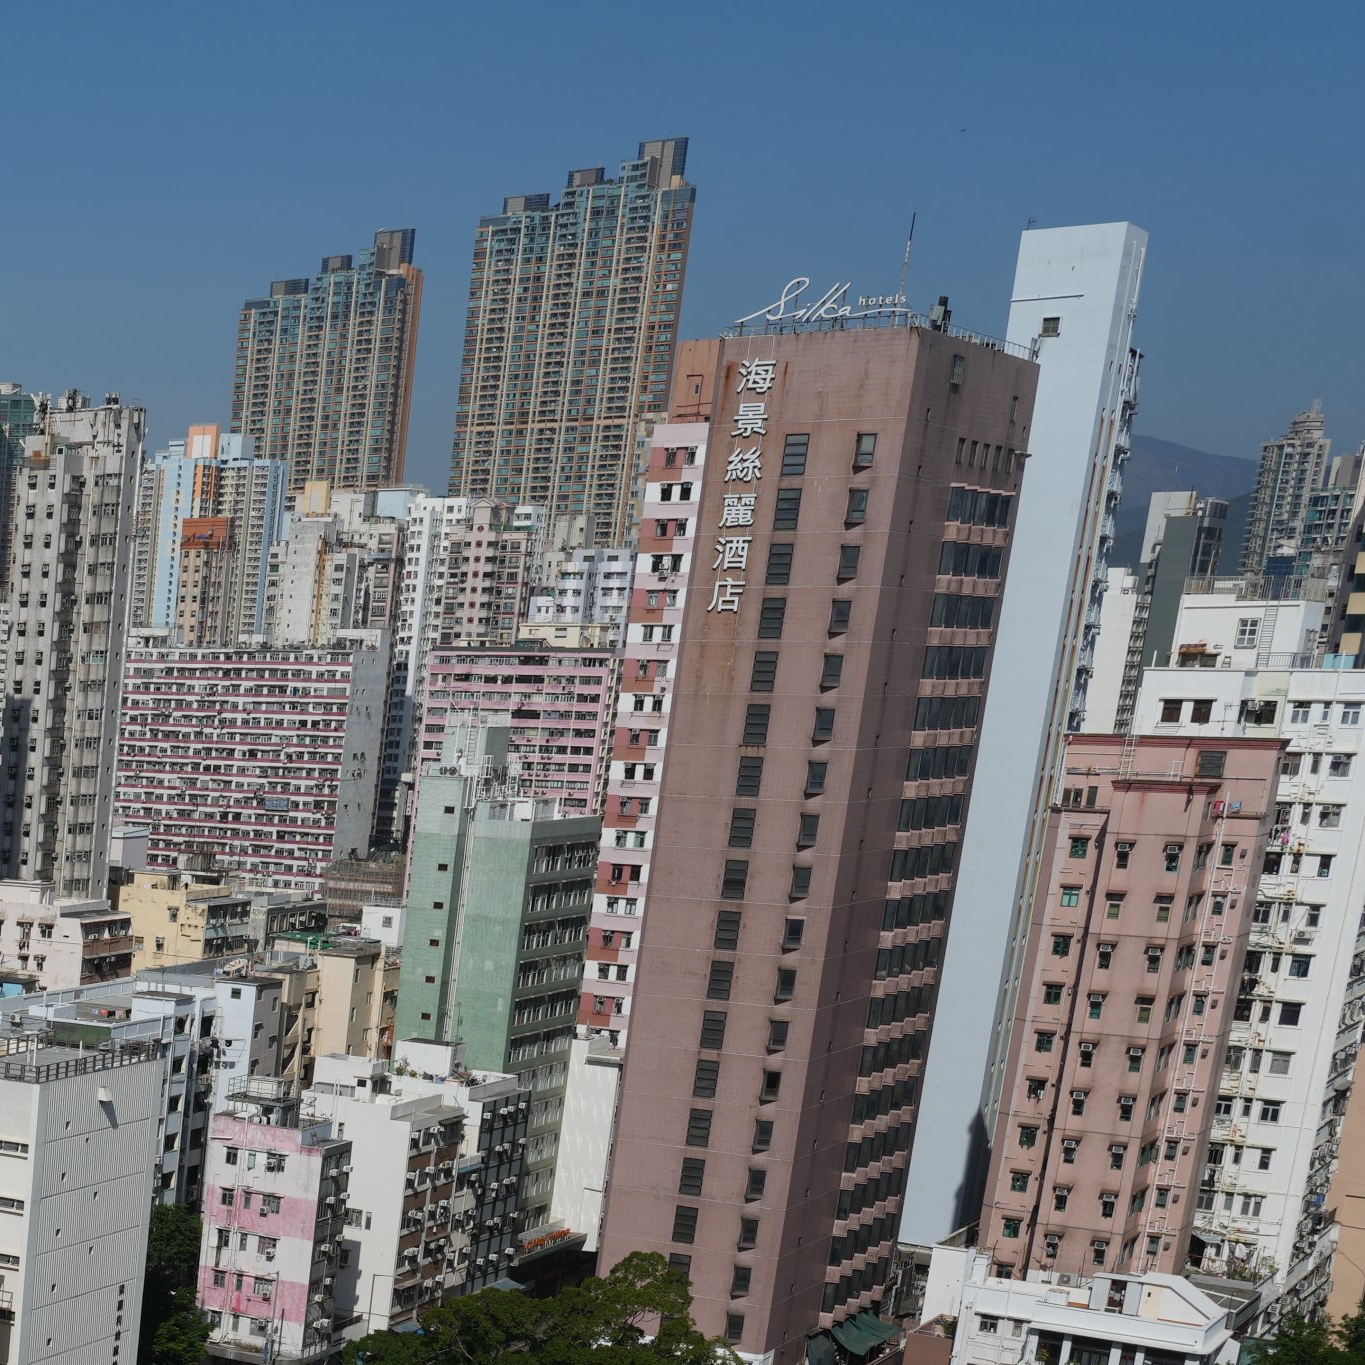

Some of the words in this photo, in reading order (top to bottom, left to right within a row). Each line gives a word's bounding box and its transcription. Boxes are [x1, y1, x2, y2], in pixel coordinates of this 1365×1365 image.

[734, 277, 911, 323] Silka
[858, 294, 907, 307] hotels
[706, 357, 777, 613] 海景絲麗酒店
